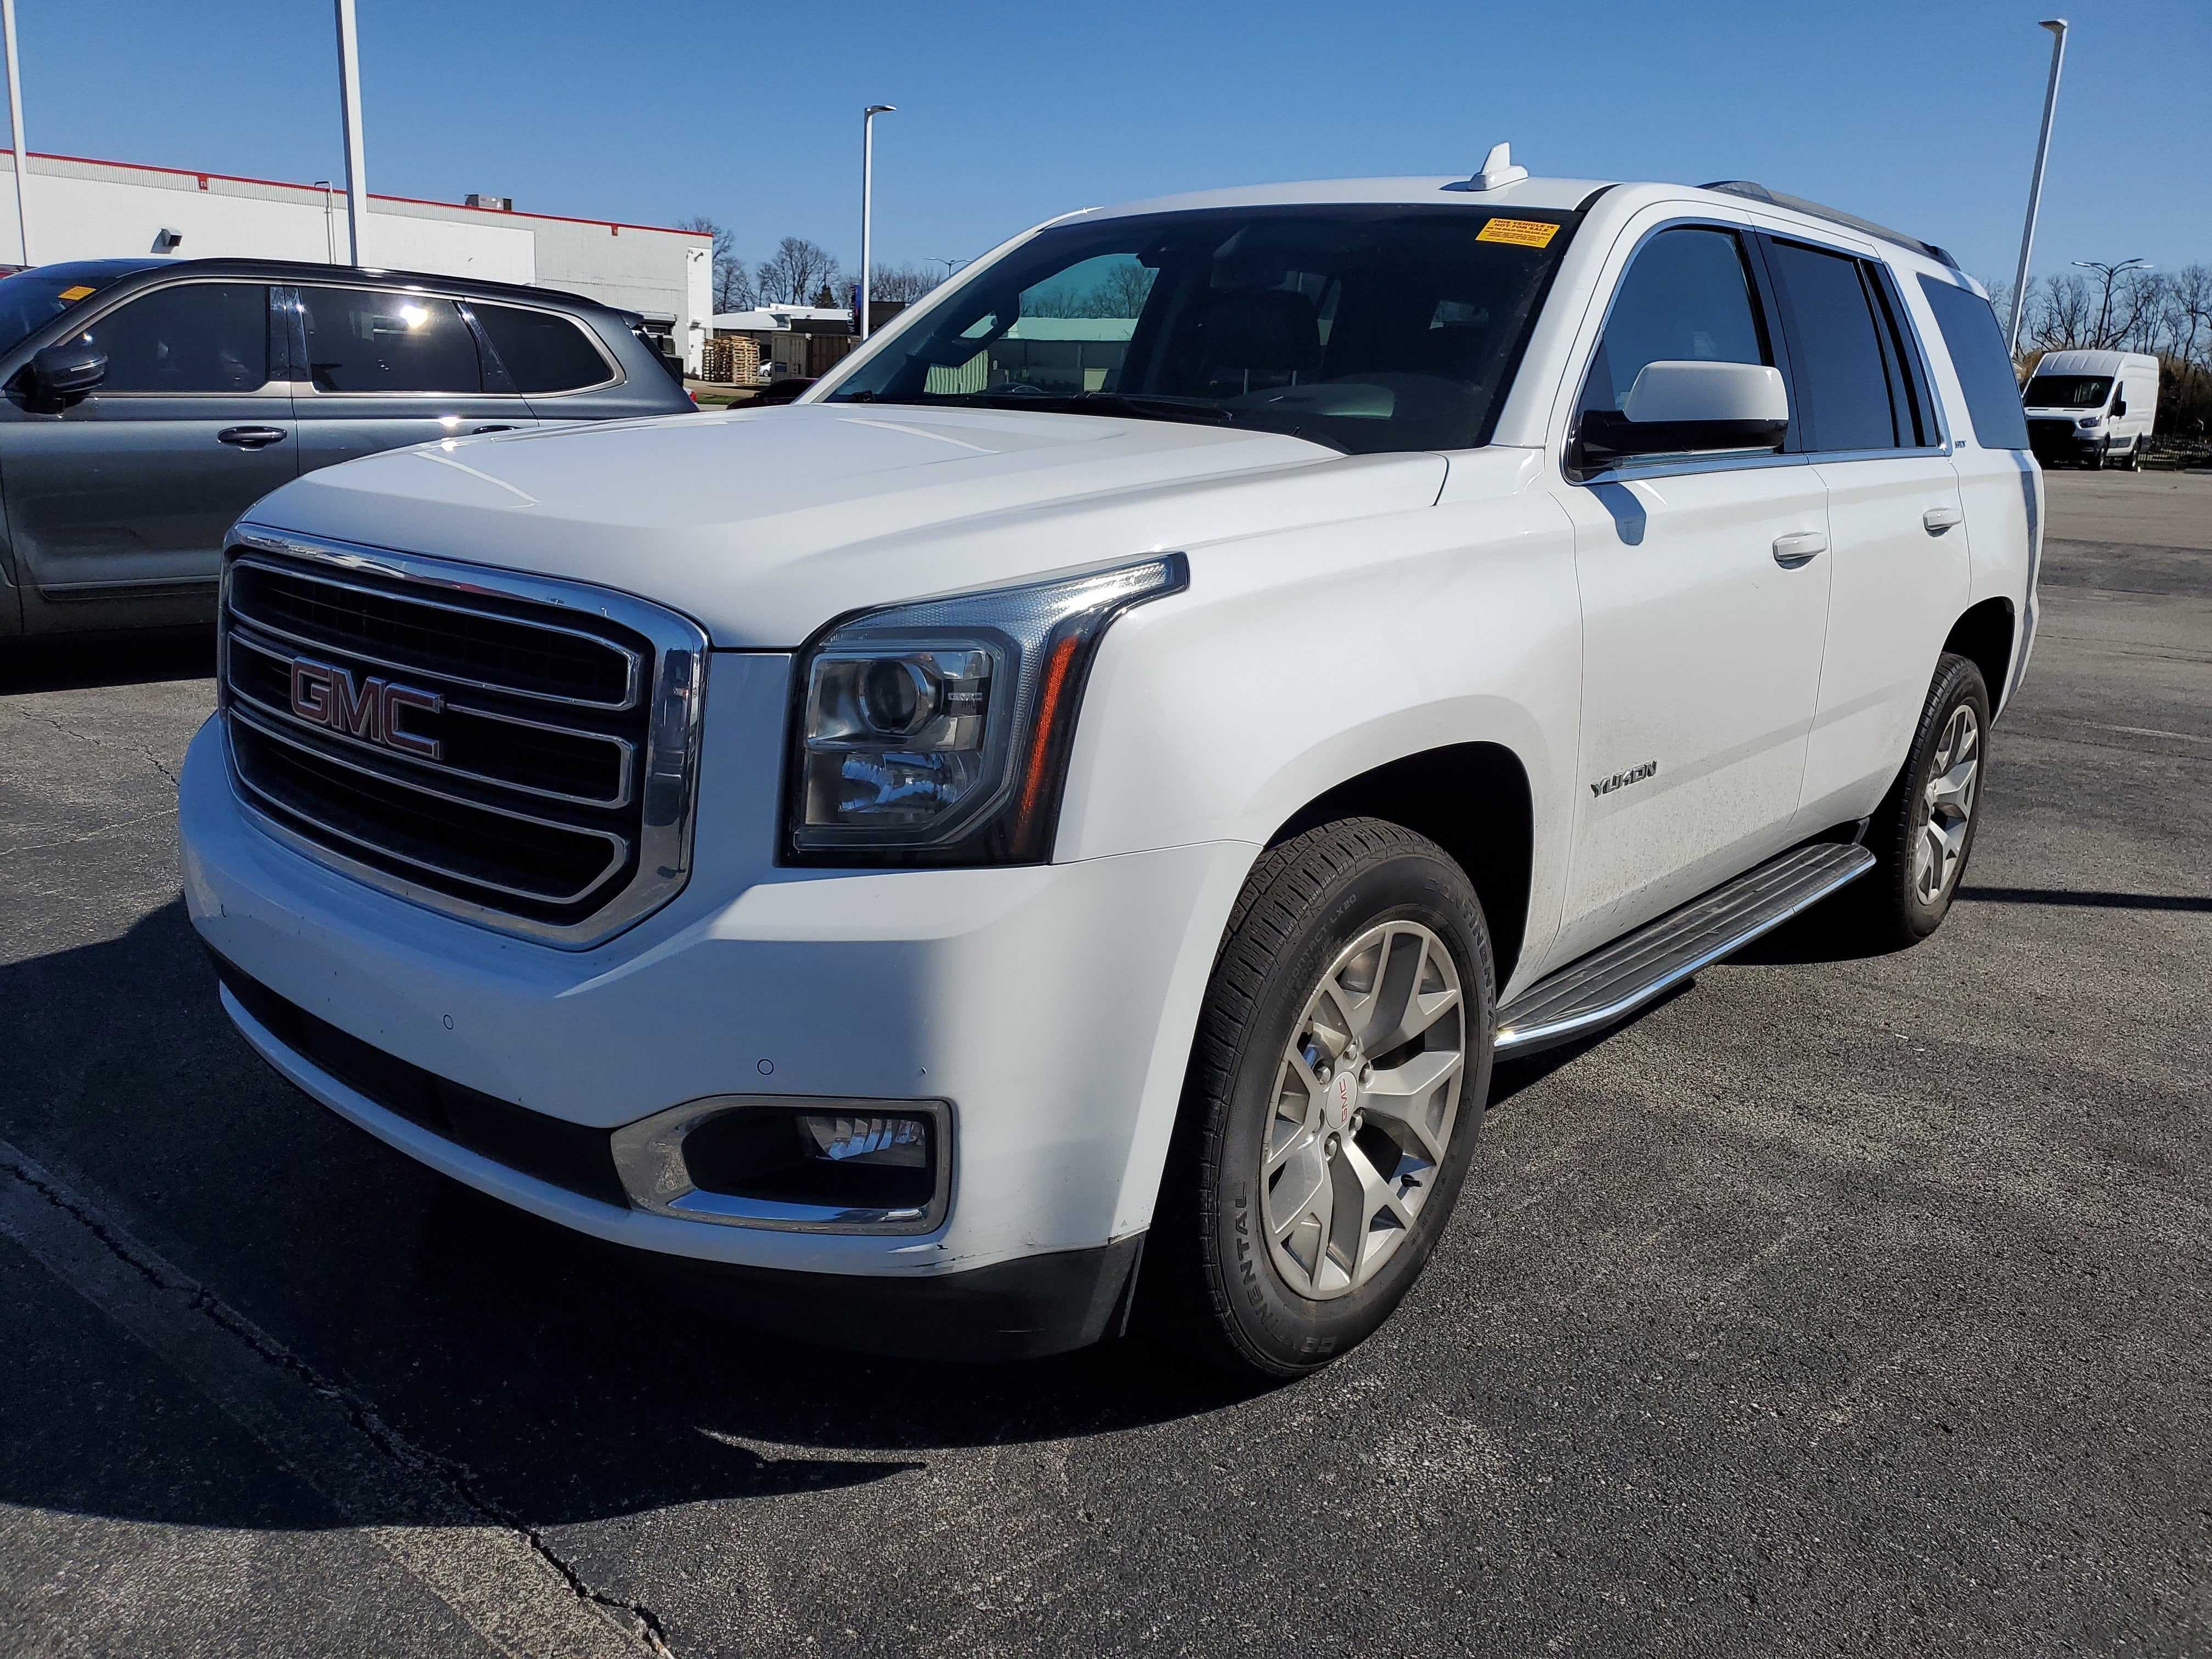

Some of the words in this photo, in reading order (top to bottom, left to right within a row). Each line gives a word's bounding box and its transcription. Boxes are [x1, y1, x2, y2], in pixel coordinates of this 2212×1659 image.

[291, 656, 442, 760] GMC
[1590, 759, 1657, 798] YUKON
[1329, 894, 1357, 924] LX20
[1339, 1077, 1347, 1122] GMC
